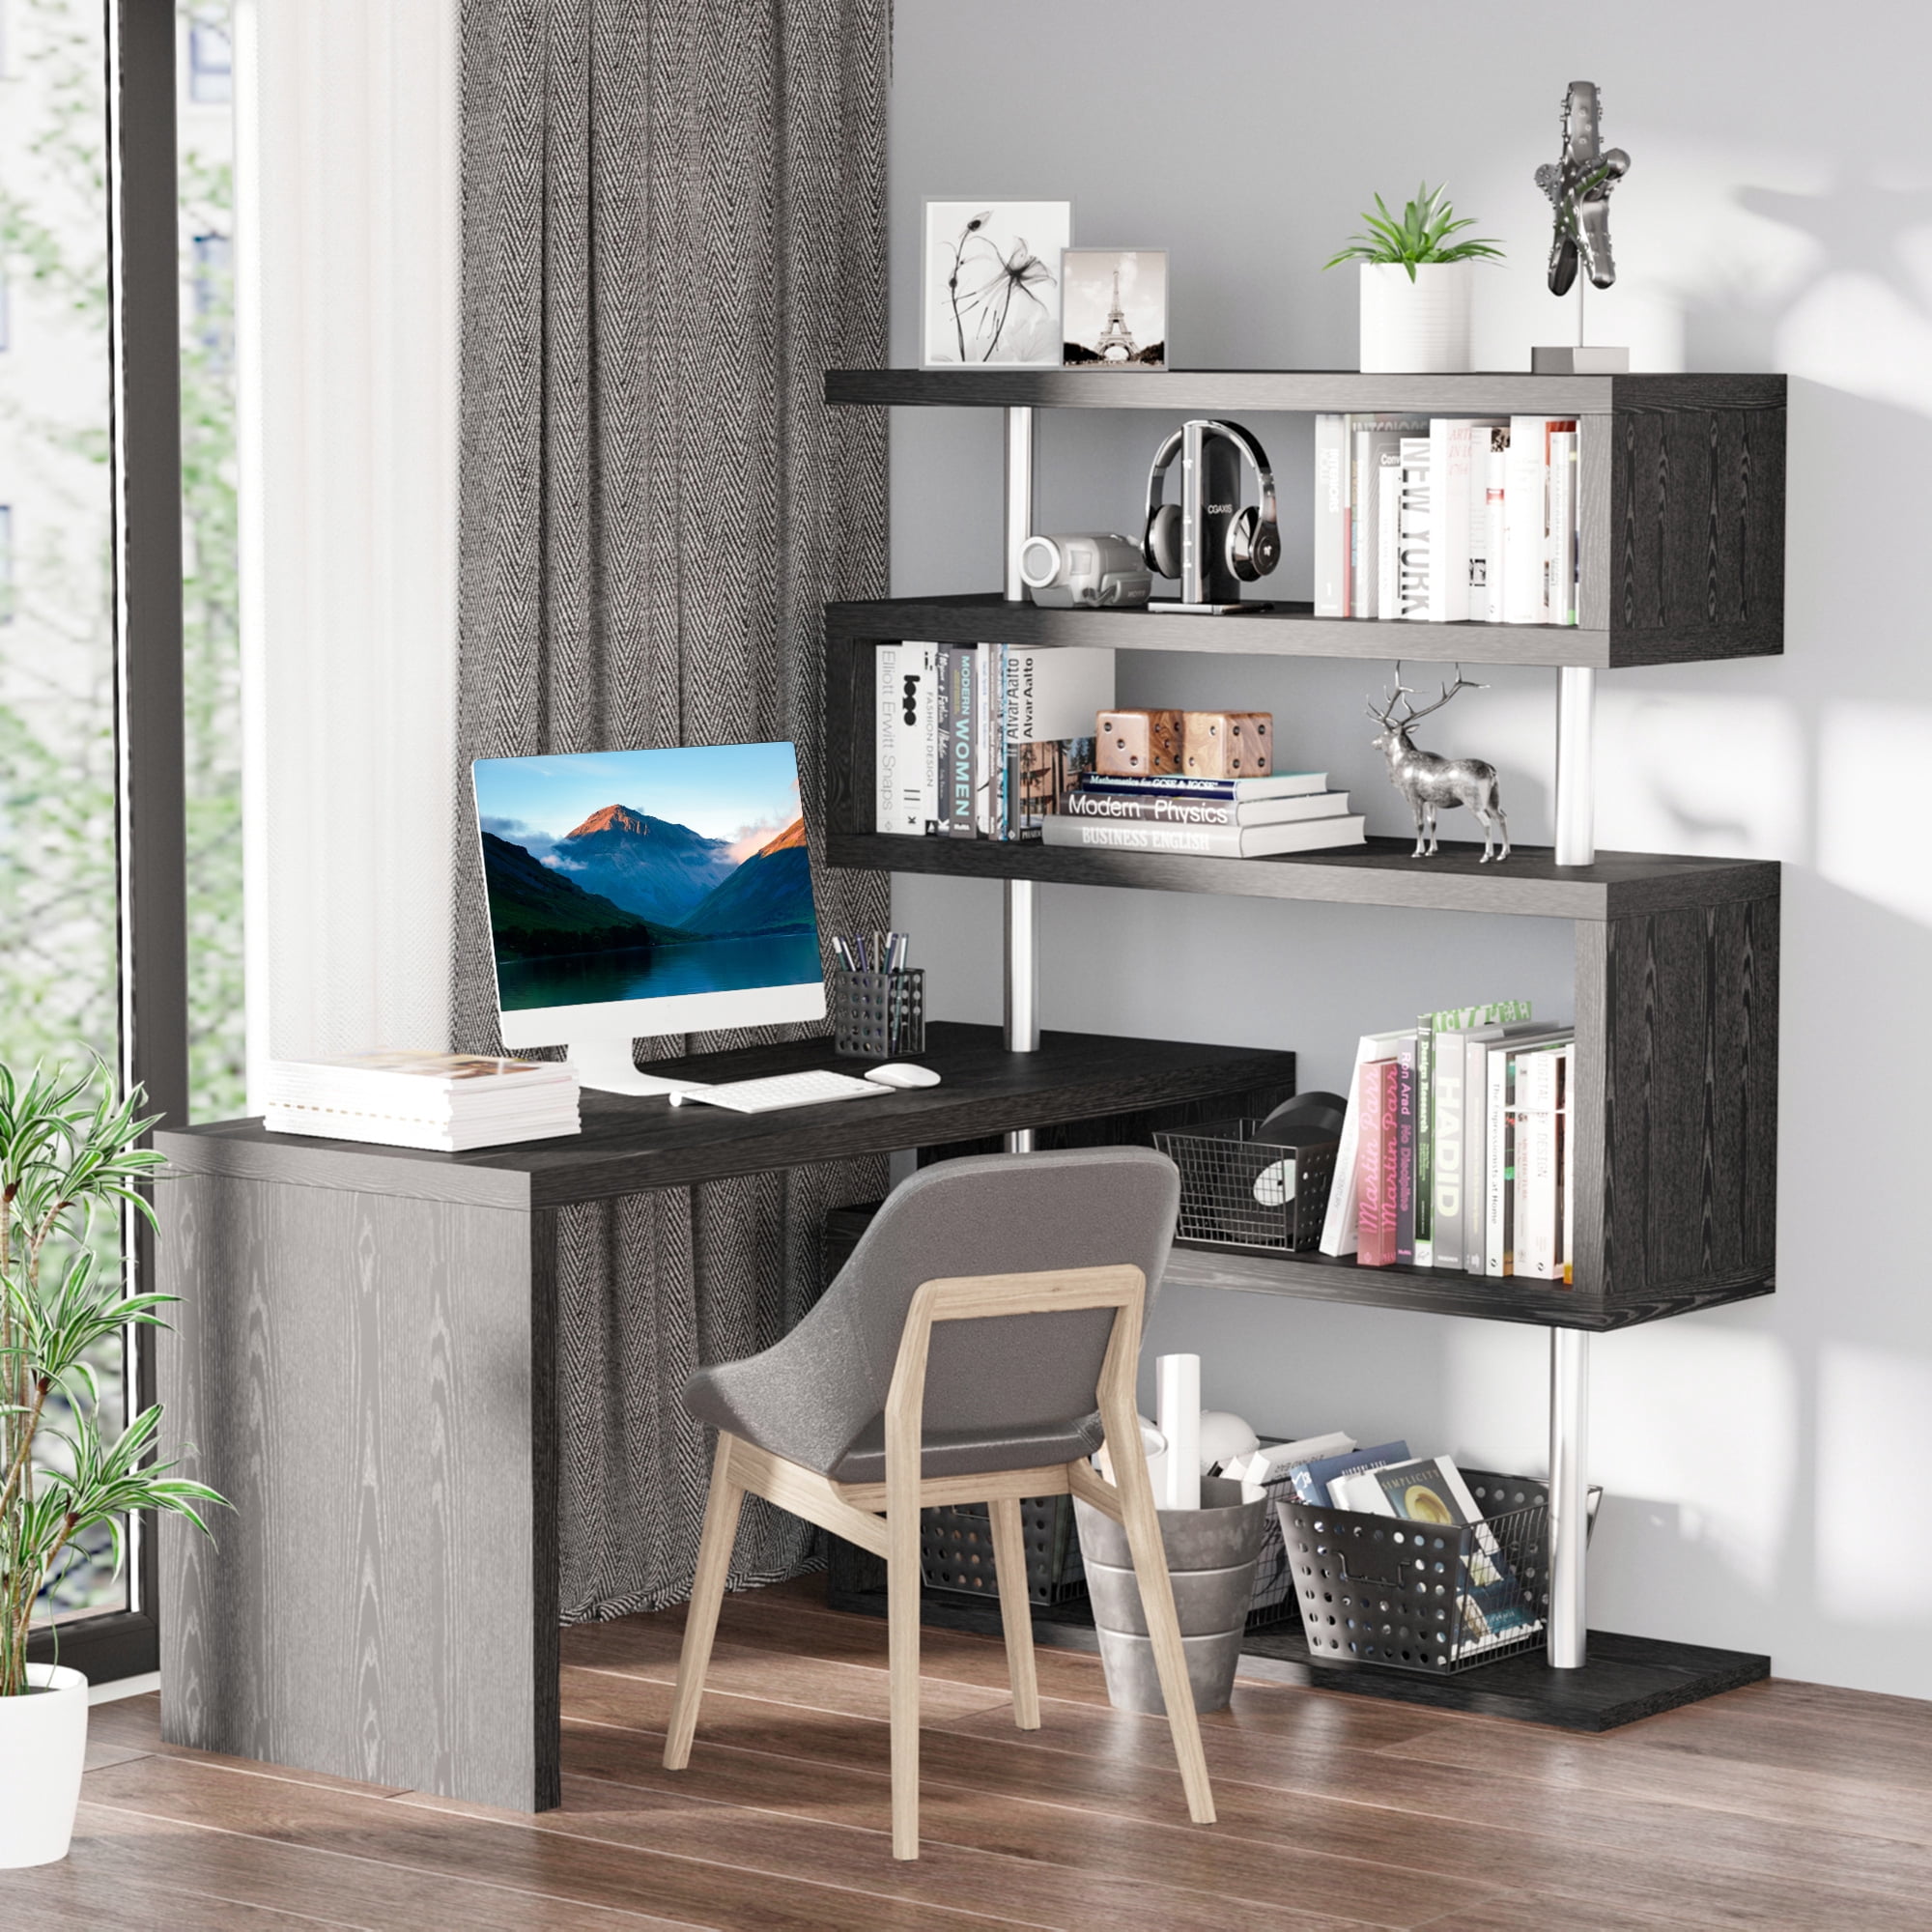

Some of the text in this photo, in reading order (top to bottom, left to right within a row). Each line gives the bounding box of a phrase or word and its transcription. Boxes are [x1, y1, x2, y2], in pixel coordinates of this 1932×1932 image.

[1208, 504, 1233, 514] CGAXIS
[1402, 440, 1431, 513] NEW
[961, 655, 971, 715] MODERN
[1007, 658, 1019, 739] Alvar Aalto
[1023, 657, 1034, 738] Alvar Aalto
[880, 650, 896, 810] Elliott Erwitt Snaps
[955, 718, 971, 816] WOMEN
[1068, 794, 1228, 824] Modern Physics
[1082, 827, 1211, 851] BUSINESS ENGLISH
[1419, 1041, 1430, 1079] Design
[1399, 1051, 1411, 1212] Ron Arad No Discipline
[1420, 1082, 1430, 1133] Research
[1359, 1066, 1378, 1235] Martin Parr
[1381, 1065, 1398, 1233] Martin Parr
[1436, 1076, 1461, 1217] HADID
[1381, 1468, 1440, 1491] SIMPLICITY
